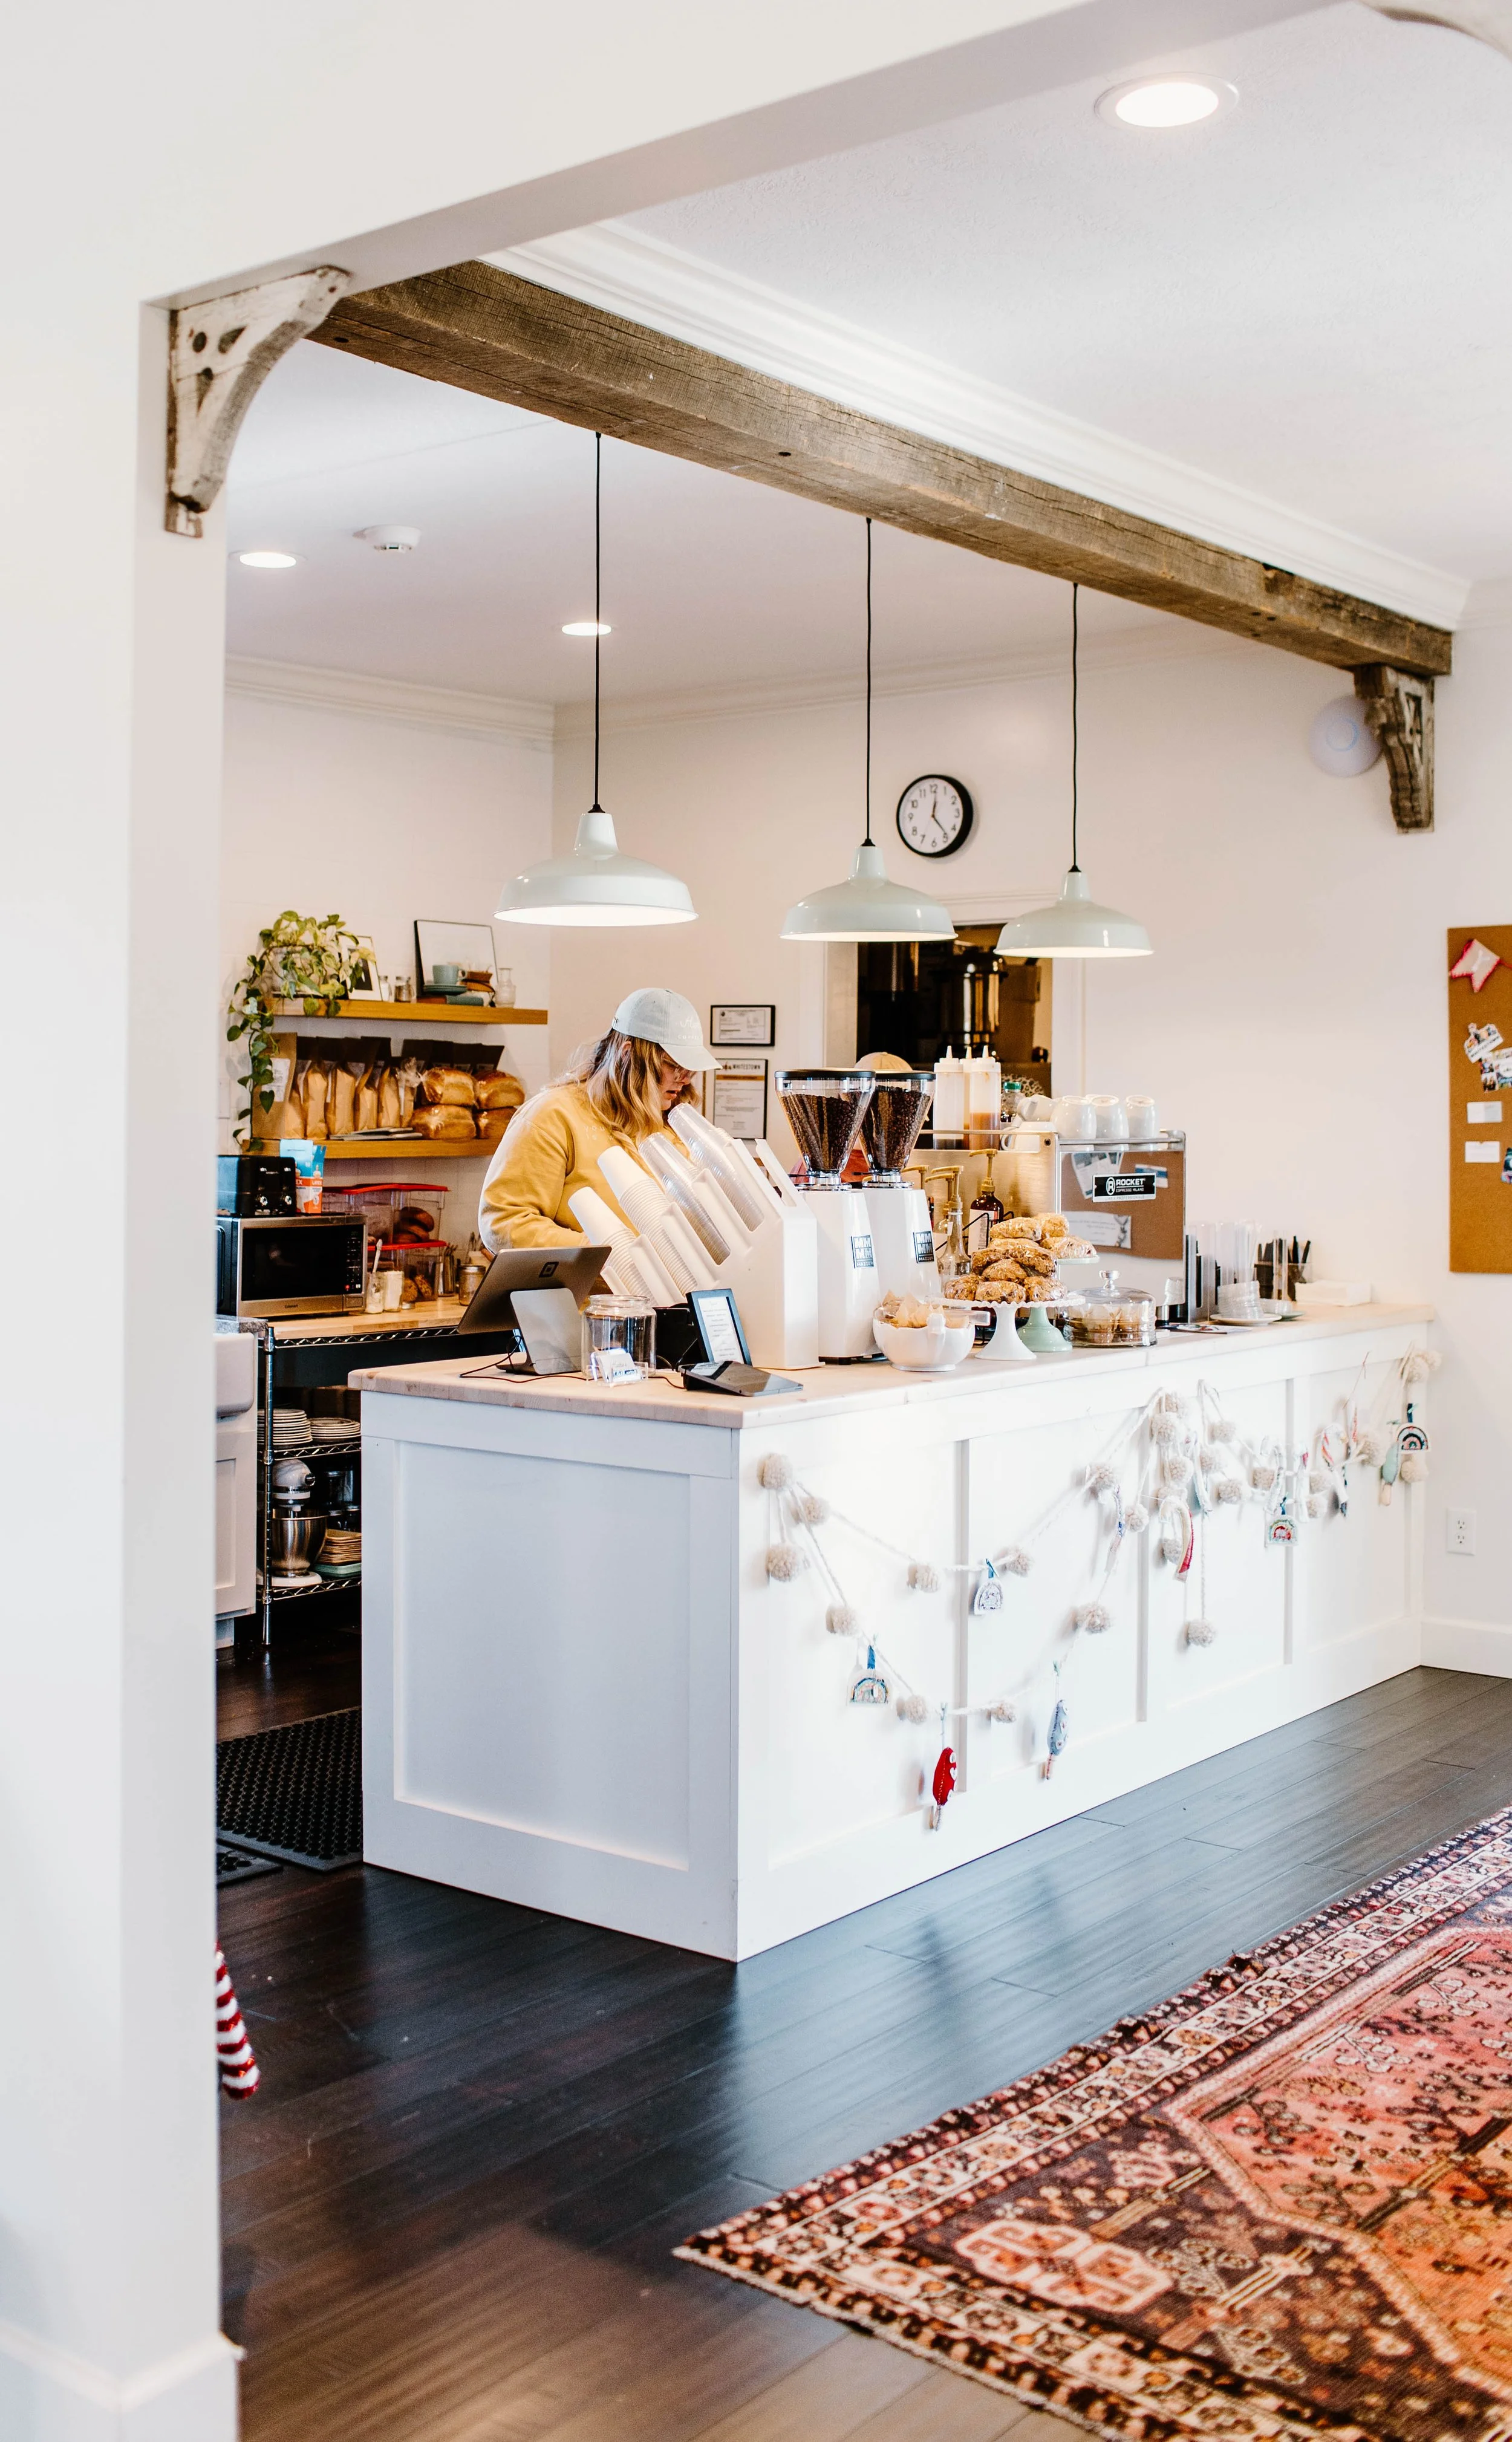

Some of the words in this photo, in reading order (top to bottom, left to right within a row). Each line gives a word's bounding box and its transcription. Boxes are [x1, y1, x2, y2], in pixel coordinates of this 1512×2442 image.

[930, 784, 938, 793] 12
[943, 786, 947, 795] 1
[919, 789, 927, 798] 11
[911, 799, 918, 809] 10
[951, 795, 957, 805] 2
[908, 812, 914, 822] 9
[954, 808, 960, 818] 3
[912, 826, 917, 836] 8
[951, 824, 956, 833] 4
[920, 835, 926, 844] 7
[931, 838, 937, 847] 6
[942, 833, 948, 843] 5
